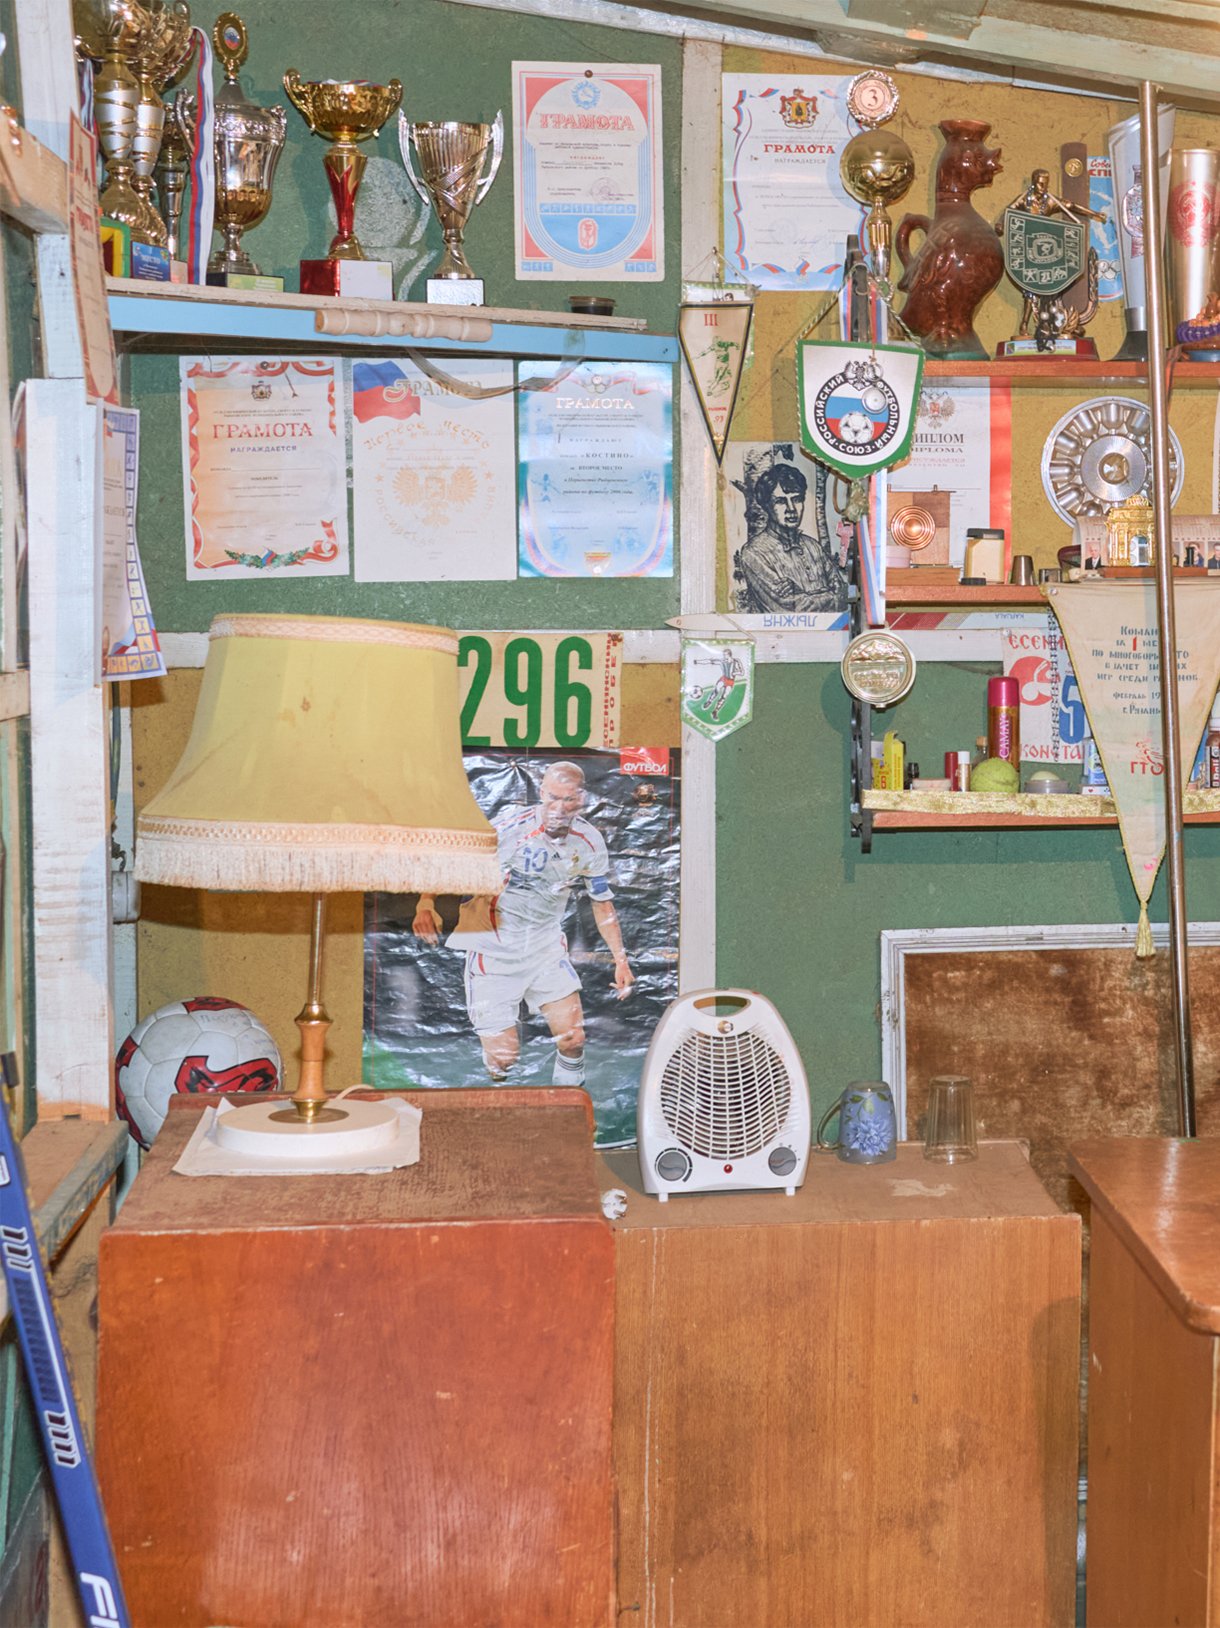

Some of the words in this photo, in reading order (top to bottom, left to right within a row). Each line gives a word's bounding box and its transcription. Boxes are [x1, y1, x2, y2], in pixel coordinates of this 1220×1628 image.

[868, 89, 878, 106] 3
[539, 113, 635, 131] ГРАМОТА
[763, 144, 836, 154] ГРАМОТА
[703, 313, 718, 327] III
[383, 379, 482, 402] ГРАМТА
[556, 398, 635, 409] ГРАМОТА
[815, 374, 845, 445] РОССИЙСКИЙ
[875, 381, 899, 449] ФУТБОЛЬНЫЙ
[212, 421, 313, 439] ГРАМОТА
[912, 433, 964, 444] ИПЛОМ
[230, 445, 297, 453] НАГРАЖДАЕТСЯ
[838, 443, 872, 455] СОЮЗ
[763, 614, 818, 628] ЛЫЖНЯ
[1133, 636, 1137, 651] 1
[1092, 649, 1104, 657] ПО
[1109, 650, 1159, 660] МНОГОБОРЬ
[1176, 650, 1189, 658] ТО
[1149, 662, 1187, 670] ЗИХ
[1153, 674, 1200, 682] РАНОВ.
[457, 635, 593, 748] 296
[1151, 692, 1160, 700] 19
[999, 717, 1010, 759] CAMAY
[623, 762, 667, 774] ФУТБОЛ
[1130, 761, 1164, 775] ГТО
[522, 846, 548, 872] 10
